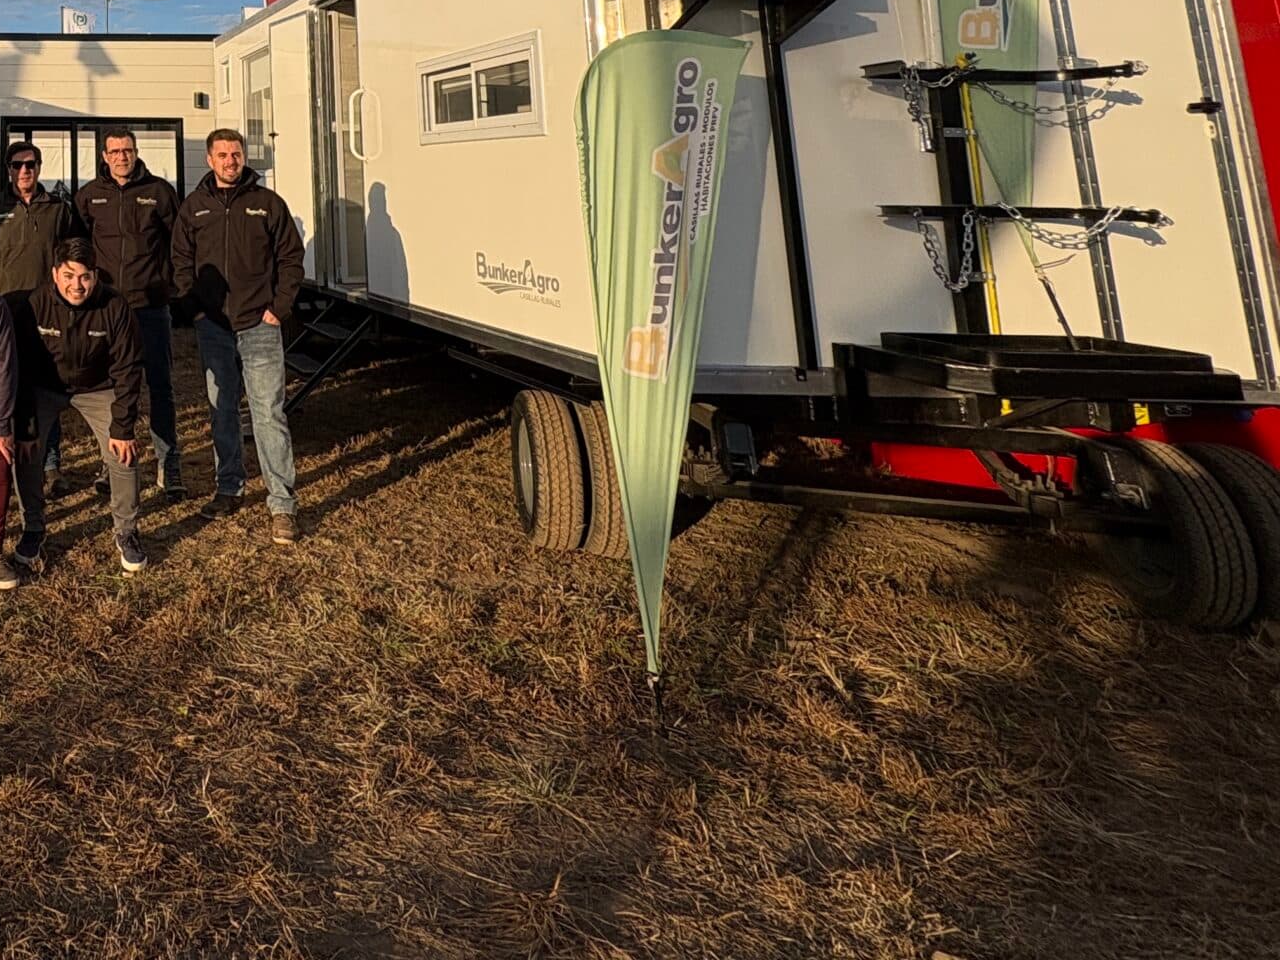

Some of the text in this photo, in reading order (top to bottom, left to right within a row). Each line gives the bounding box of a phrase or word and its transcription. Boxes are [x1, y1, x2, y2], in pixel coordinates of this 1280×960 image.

[625, 60, 699, 377] BunkerAgro
[689, 191, 701, 241] CASILLAS
[695, 141, 706, 189] RURALES
[701, 81, 715, 134] MODULOS
[700, 134, 716, 212] HABITACIONES
[476, 252, 560, 294] BunkerAgro
